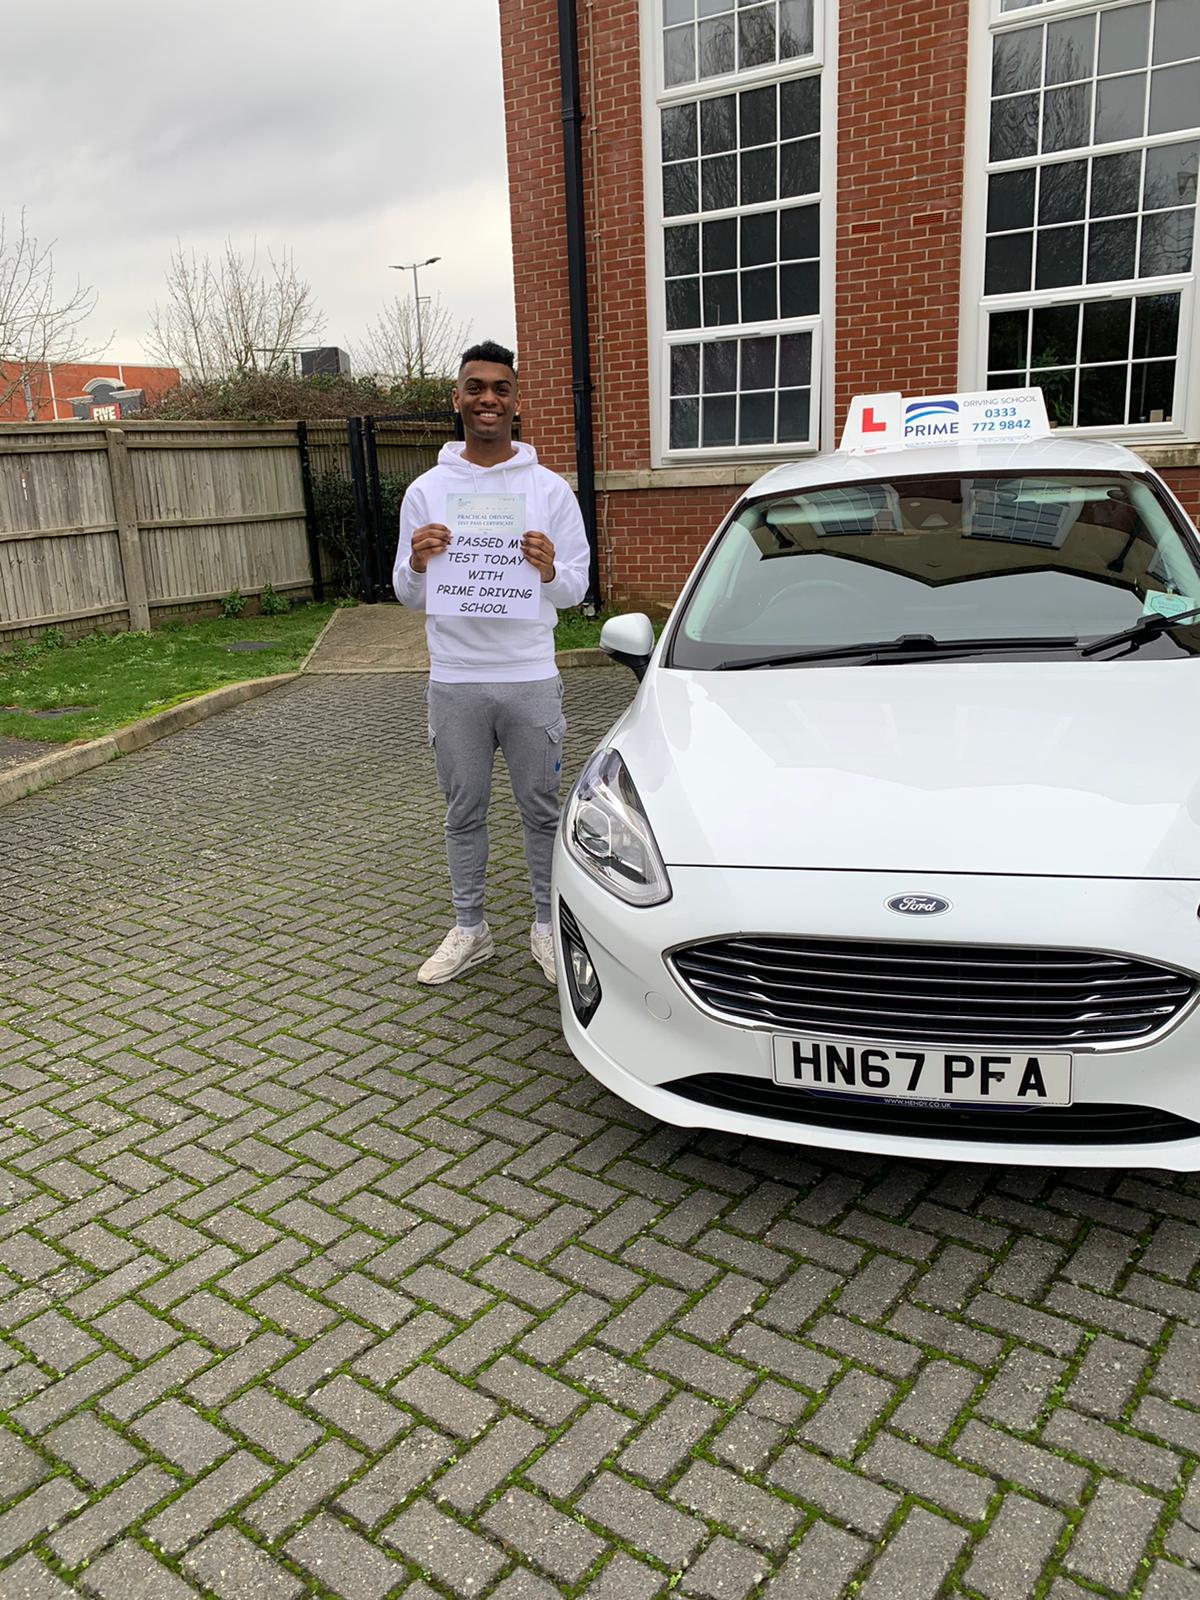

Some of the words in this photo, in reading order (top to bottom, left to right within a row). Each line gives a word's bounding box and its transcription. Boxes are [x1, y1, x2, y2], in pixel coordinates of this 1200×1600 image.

[963, 399, 999, 407] DRIVING
[1001, 395, 1037, 404] SCHOOL
[93, 406, 116, 420] FIVE
[985, 407, 1017, 418] 0333
[862, 407, 887, 432] L
[972, 422, 996, 432] 772
[999, 419, 1031, 430] 9842
[904, 421, 959, 437] PRIME
[456, 536, 504, 549] PASSED
[448, 552, 479, 563] TEST
[484, 554, 525, 566] TODAY
[468, 570, 504, 581] WITH
[436, 584, 475, 596] PRIME
[479, 587, 533, 599] DRIVING
[459, 602, 508, 614] SCHOOL
[899, 896, 937, 911] Ford
[792, 1041, 926, 1092] HN67
[944, 1054, 1048, 1098] PFA
[883, 1098, 952, 1109] WWW.HENDY.CO.UK
